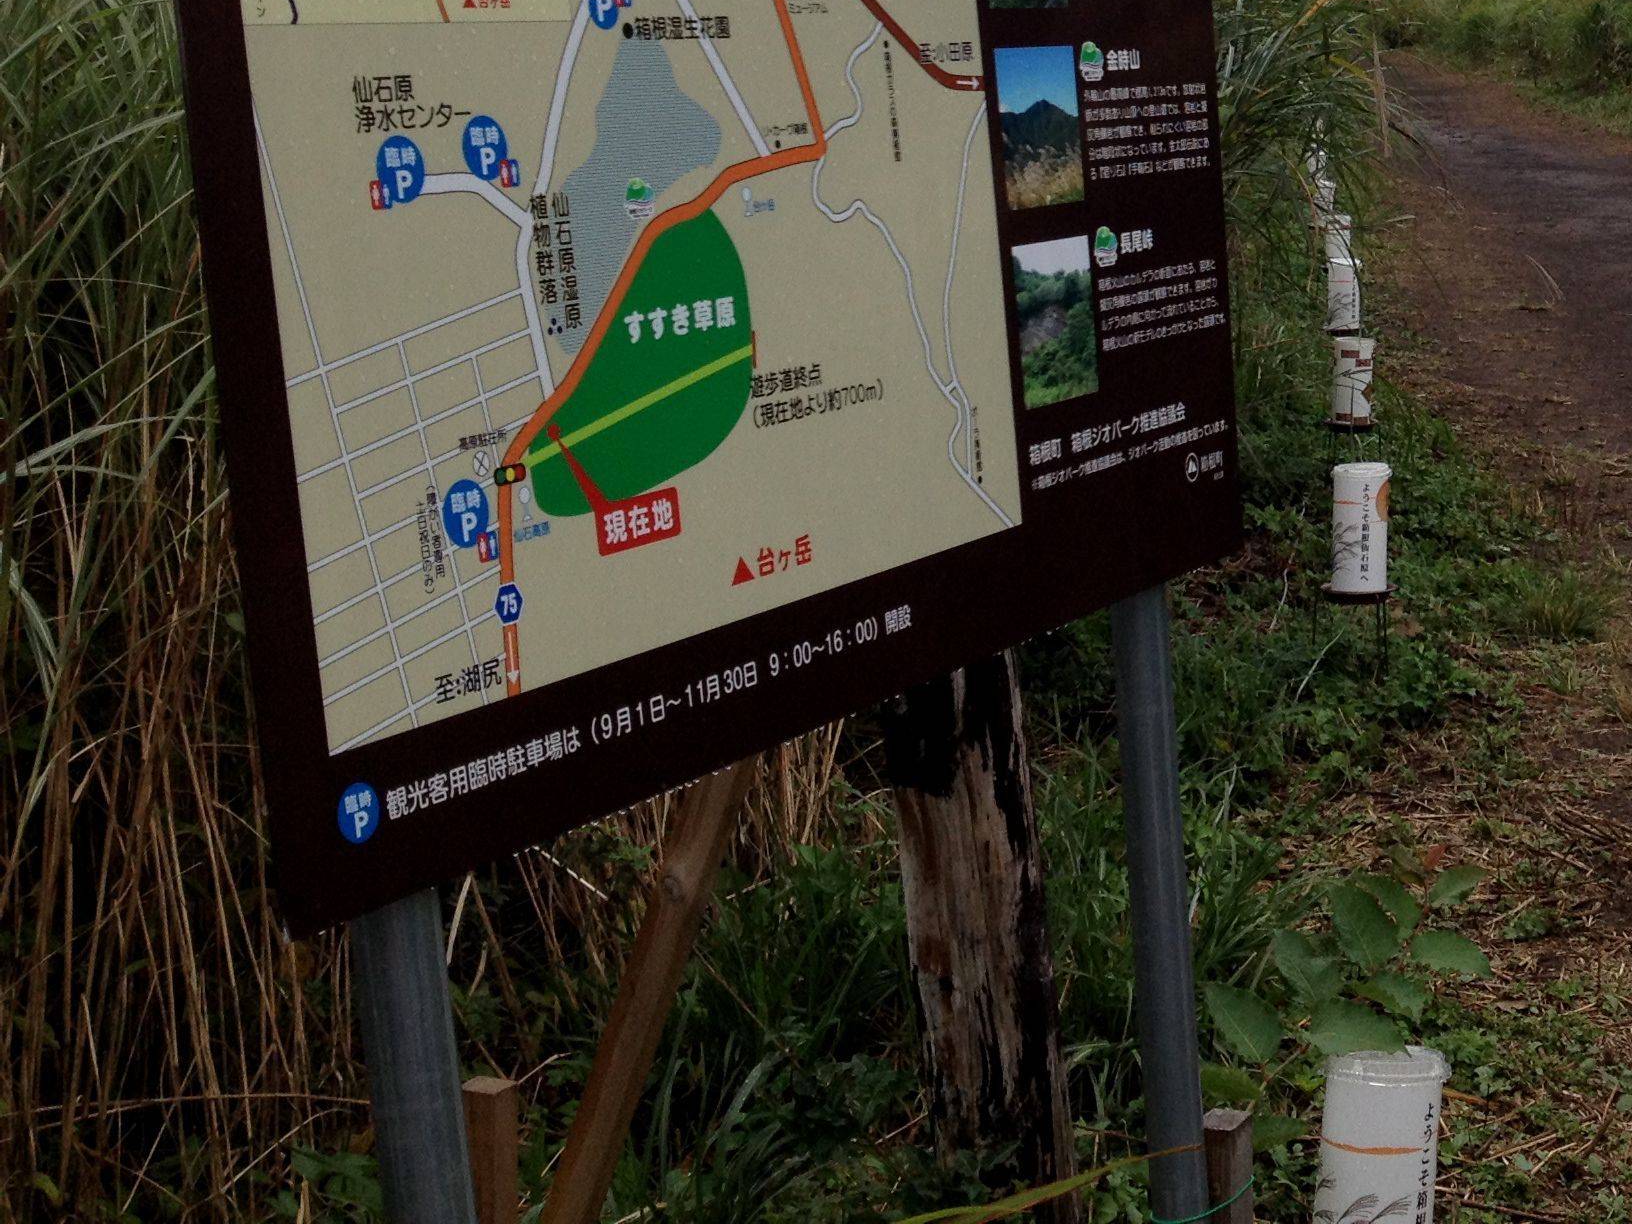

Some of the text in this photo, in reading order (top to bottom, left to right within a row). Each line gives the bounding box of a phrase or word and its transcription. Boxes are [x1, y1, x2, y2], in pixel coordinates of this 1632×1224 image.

[352, 74, 415, 104] 仙石原
[355, 102, 471, 134] 浄水センター
[530, 192, 558, 306] 植物群落
[624, 295, 736, 344] すすき草原
[451, 488, 481, 514] 臨時
[461, 512, 478, 543] P
[604, 498, 674, 544] 現在地
[501, 592, 518, 616] 75
[385, 726, 581, 822] 観光客用臨時駐車場は
[343, 789, 373, 817] 臨時
[353, 810, 369, 839] P
